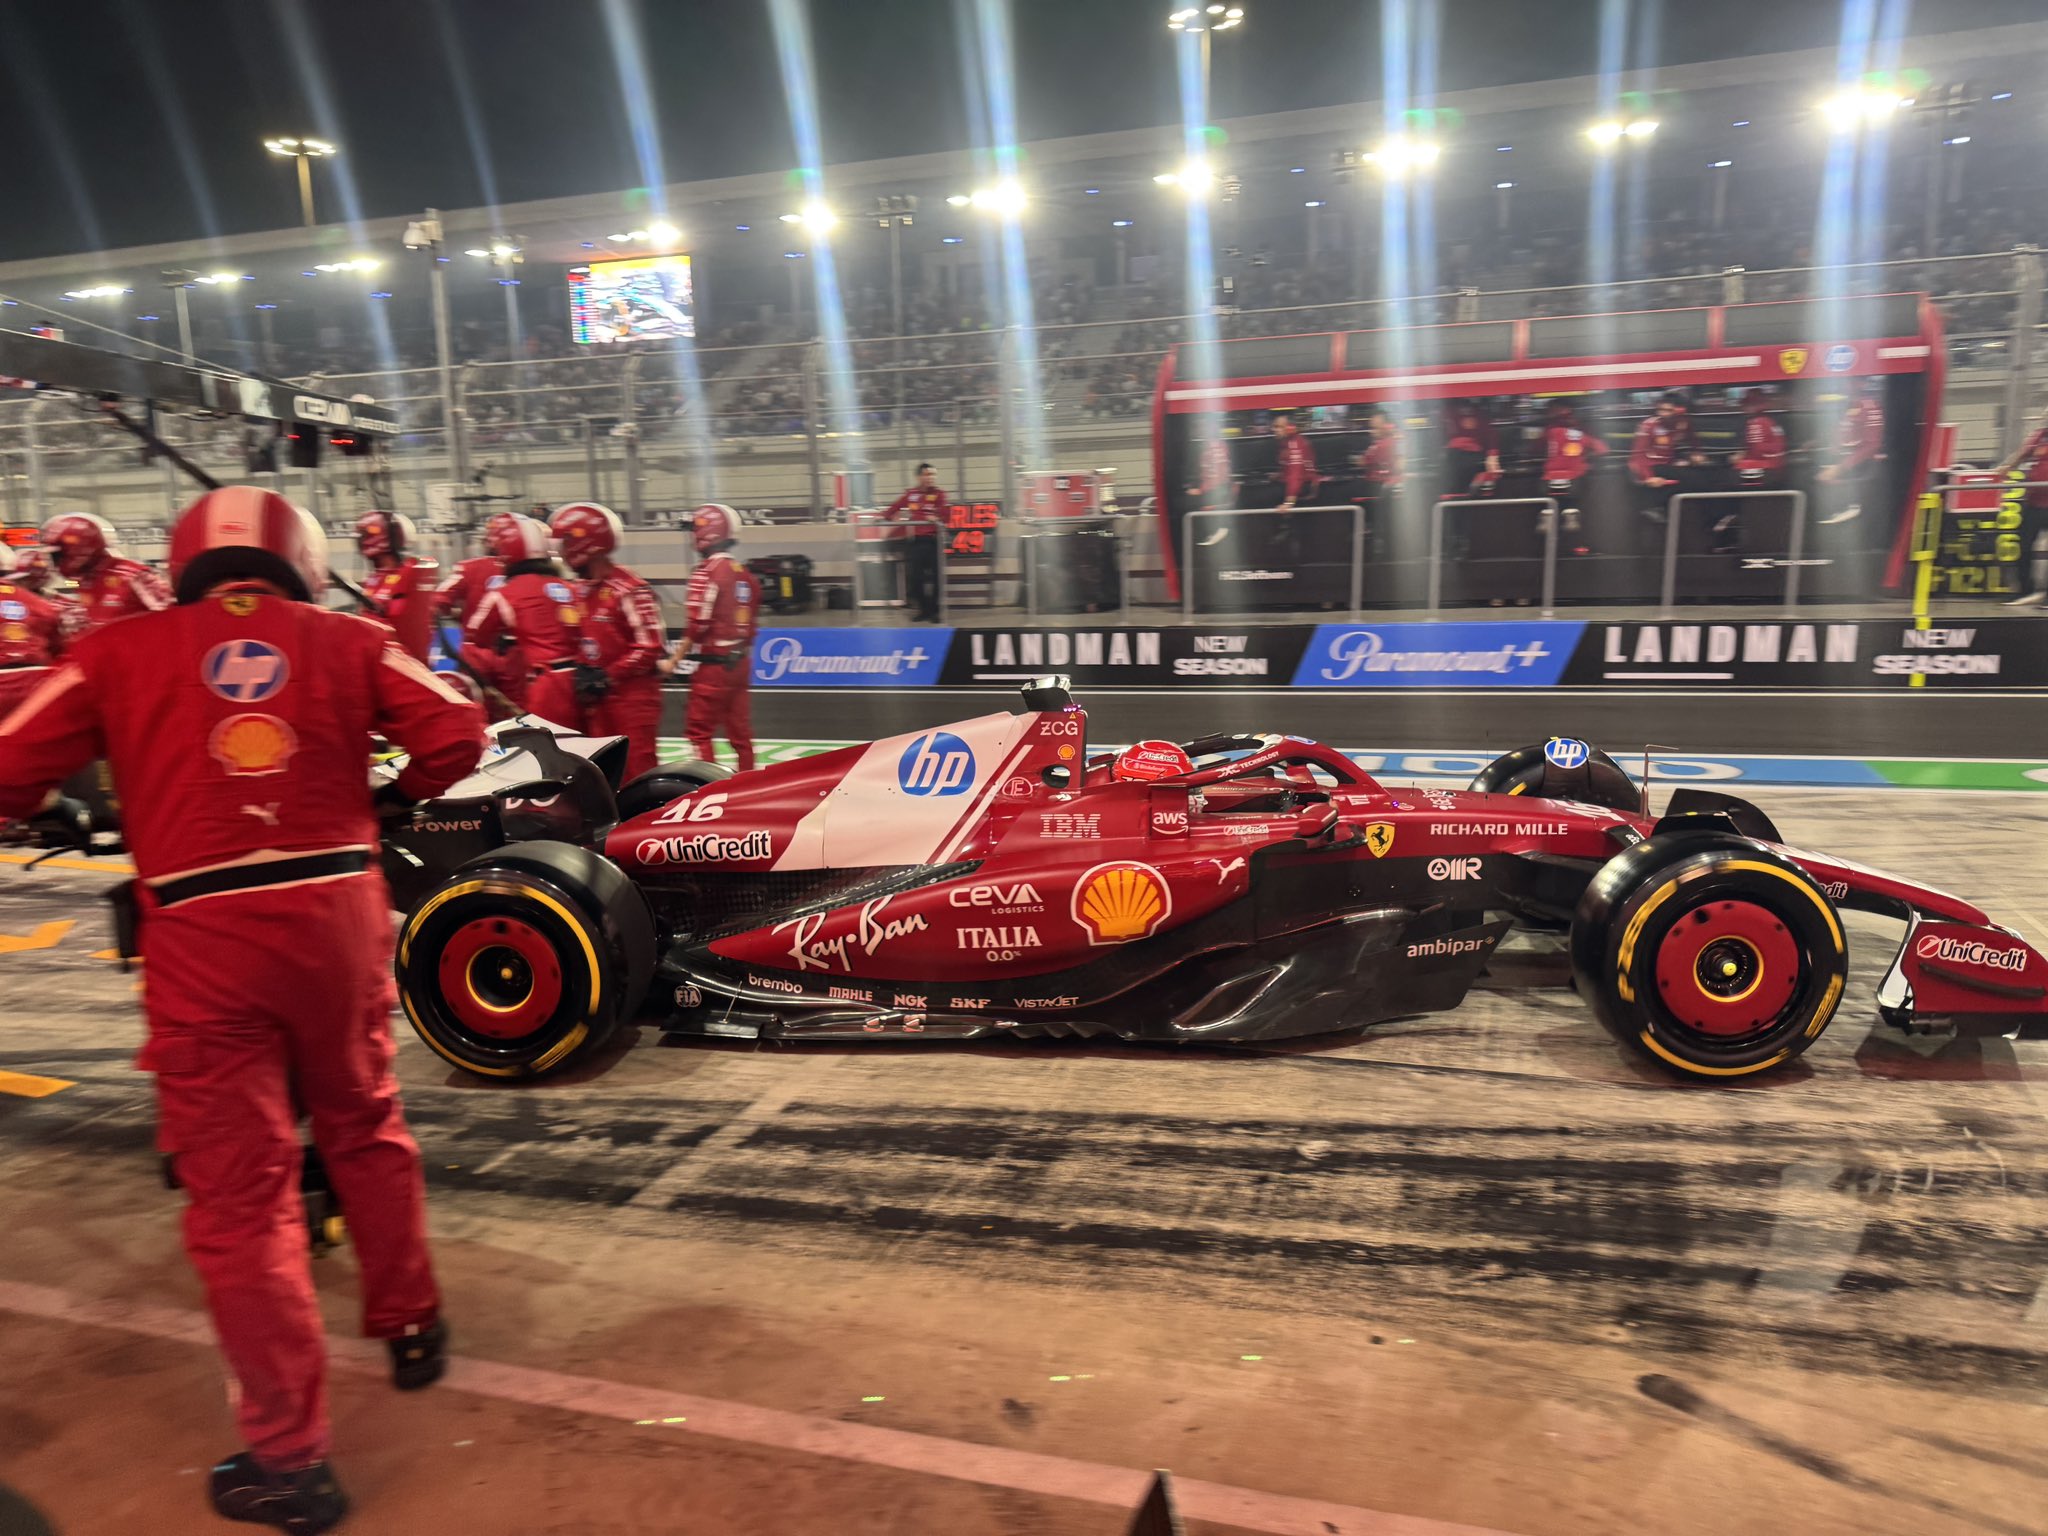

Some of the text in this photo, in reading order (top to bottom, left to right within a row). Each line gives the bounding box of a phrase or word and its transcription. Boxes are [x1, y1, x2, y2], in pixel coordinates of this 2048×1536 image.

[1194, 636, 1248, 652] NEW
[1604, 625, 1859, 662] LANDMAN
[1903, 629, 1977, 648] NEW
[971, 633, 1160, 665] LANDMAN
[1173, 658, 1268, 675] SEASON
[1872, 654, 2000, 675] SEASON
[1240, 751, 1279, 769] TECHNOLOGY
[1549, 738, 1584, 769] hp
[905, 732, 971, 797] hp
[651, 793, 729, 824] 16
[1153, 812, 1188, 824] aws
[1040, 814, 1101, 838] IBM
[1430, 823, 1569, 835] RICHARD MILLE
[665, 830, 772, 863] UniCredit
[992, 906, 1045, 915] LOGISTICS
[956, 926, 1043, 949] ITALIA
[1406, 938, 1484, 957] ambipar
[1940, 939, 2027, 971] UniCredit
[748, 973, 803, 994] brembo
[676, 988, 699, 1003] FIA
[829, 986, 873, 1002] MAHLE
[893, 994, 928, 1008] NGK
[950, 997, 991, 1009] SKF
